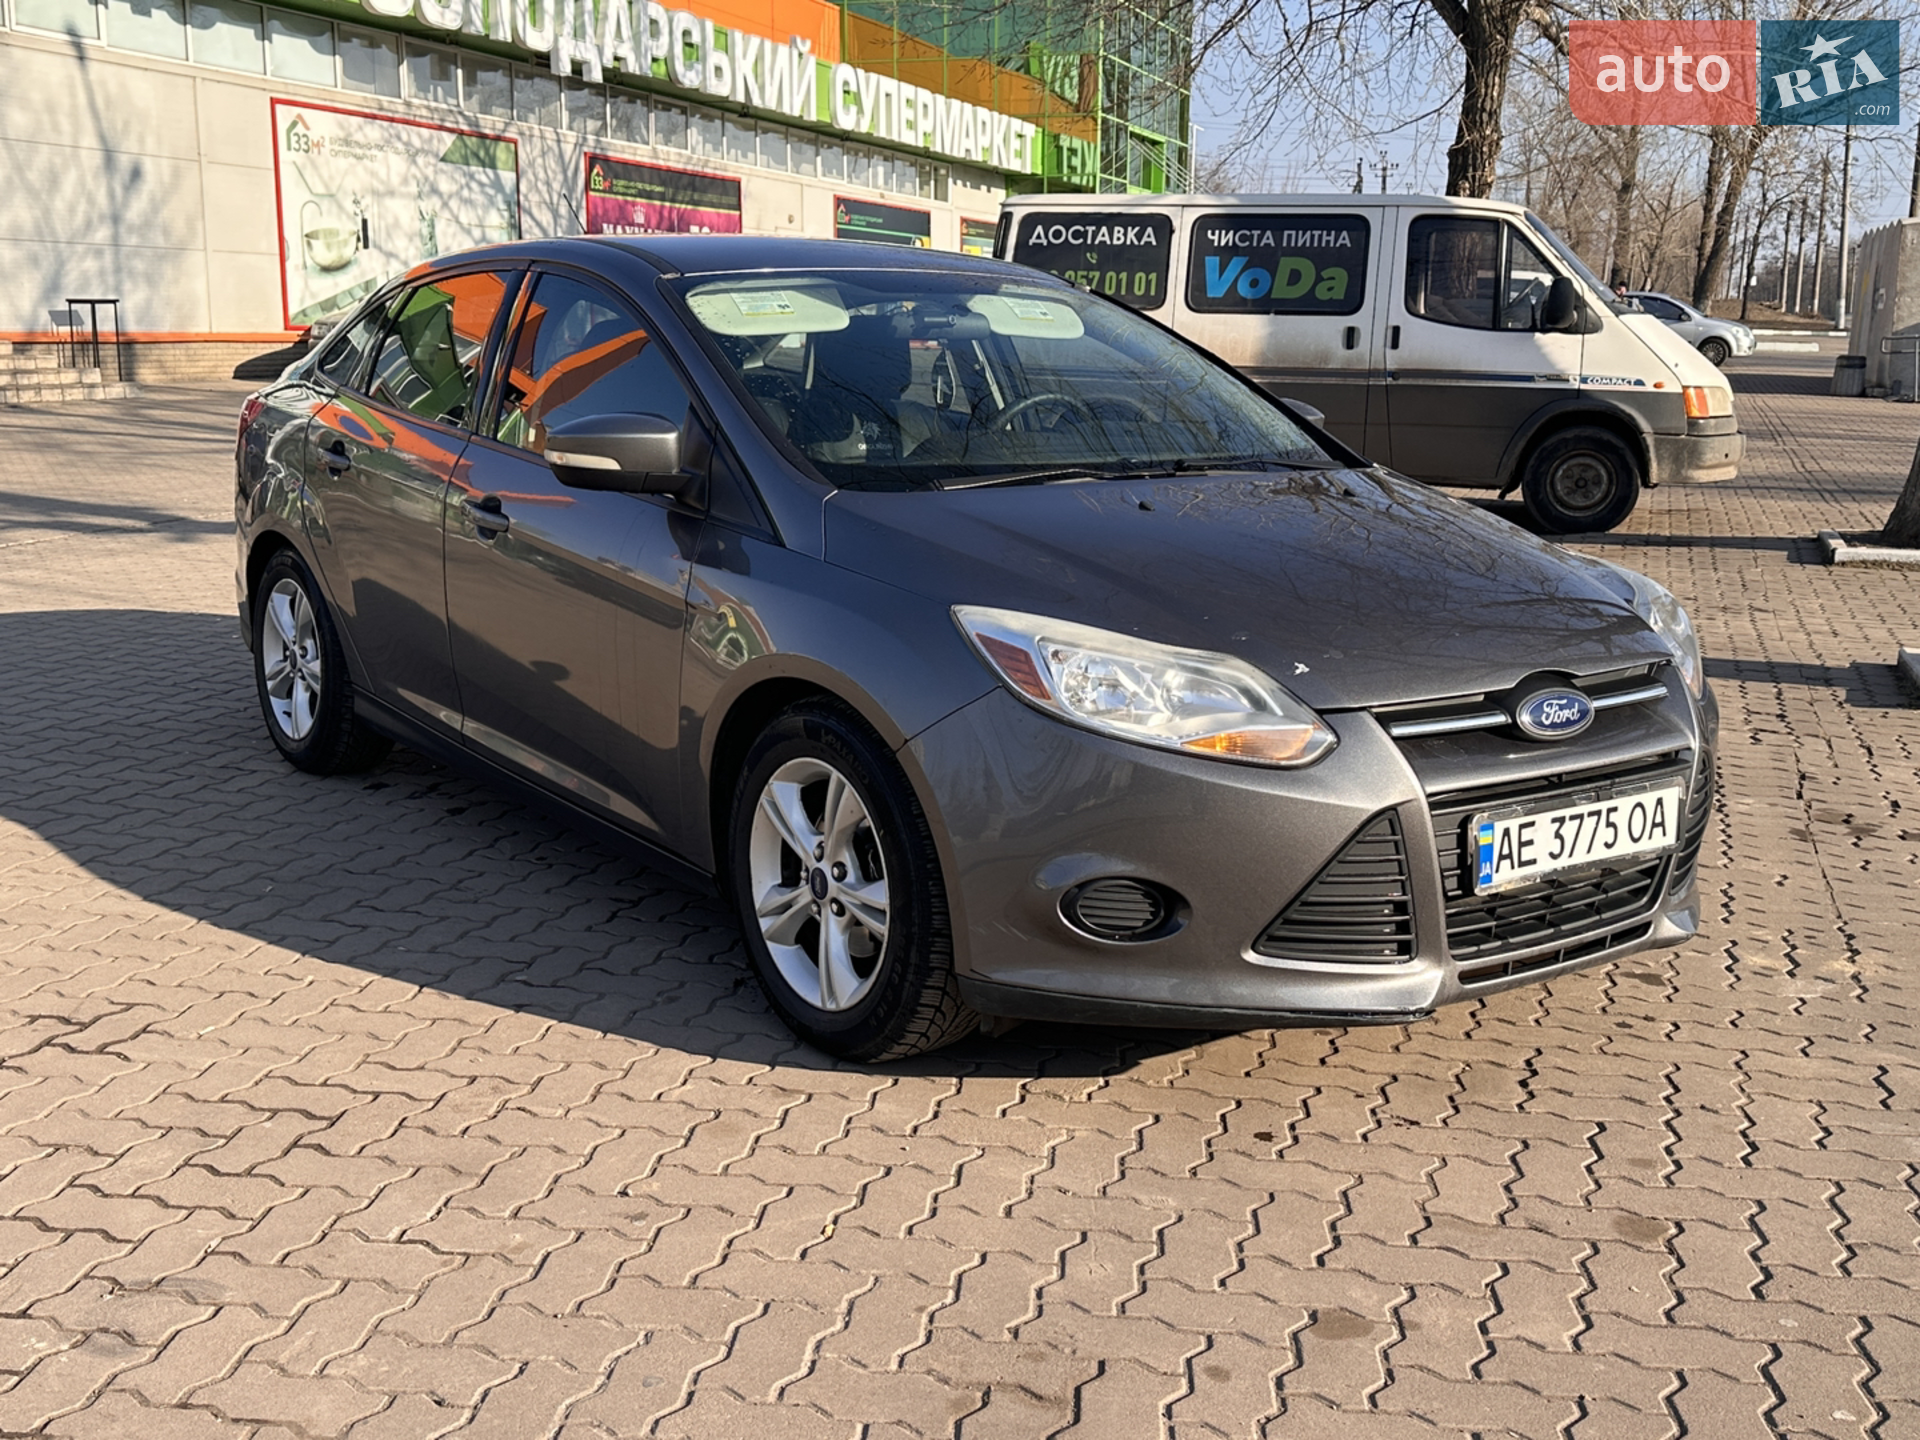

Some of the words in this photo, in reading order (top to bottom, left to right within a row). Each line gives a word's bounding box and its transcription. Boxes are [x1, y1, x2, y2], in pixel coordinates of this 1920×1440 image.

[831, 62, 1036, 175] СУПЕРМАРКЕТ
[1028, 224, 1157, 247] ДОСТАВКА
[1207, 229, 1275, 247] ЧИСТА
[1282, 229, 1352, 248] ПИТНА
[1104, 270, 1128, 296] 01
[1133, 271, 1157, 296] 01
[1204, 255, 1349, 300] VoDa
[1586, 376, 1635, 386] COMPACT
[1541, 698, 1581, 726] Ford
[1494, 820, 1538, 875] AE
[1548, 806, 1619, 861] 3775
[1627, 796, 1667, 844] OA
